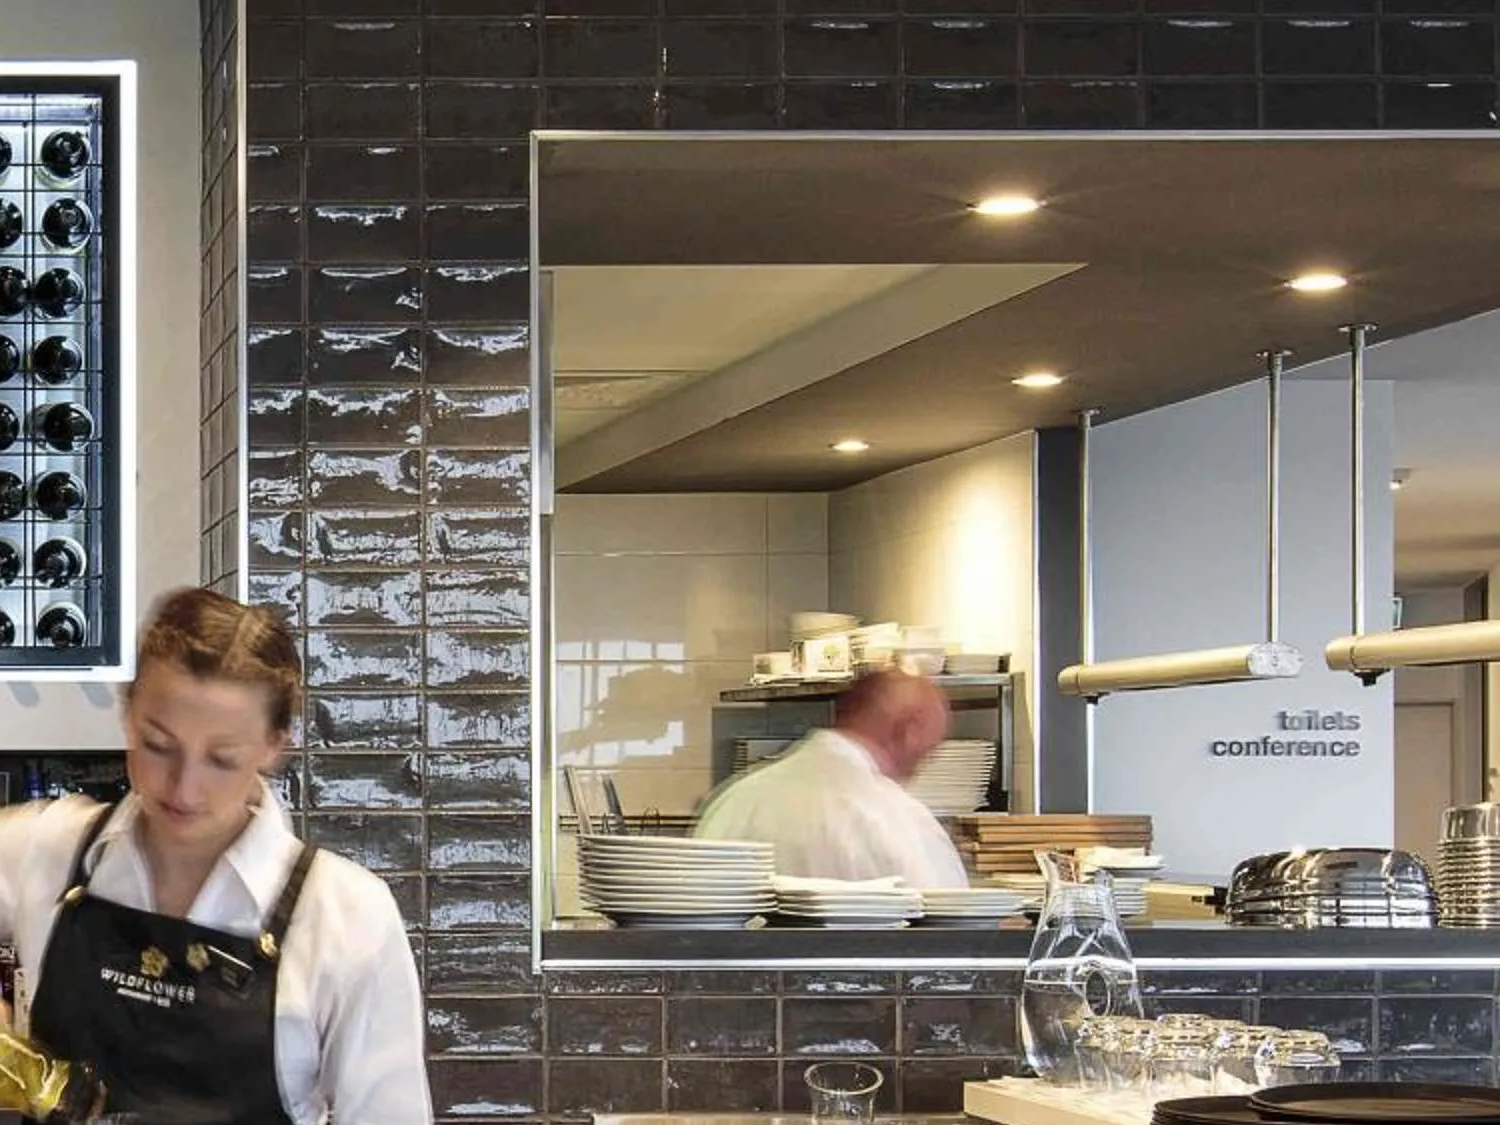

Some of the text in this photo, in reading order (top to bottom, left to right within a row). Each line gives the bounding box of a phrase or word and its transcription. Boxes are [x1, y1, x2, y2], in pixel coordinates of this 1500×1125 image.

[1277, 710, 1361, 731] toilets
[1211, 736, 1361, 757] conference
[101, 967, 197, 1004] WILDFLOWER
